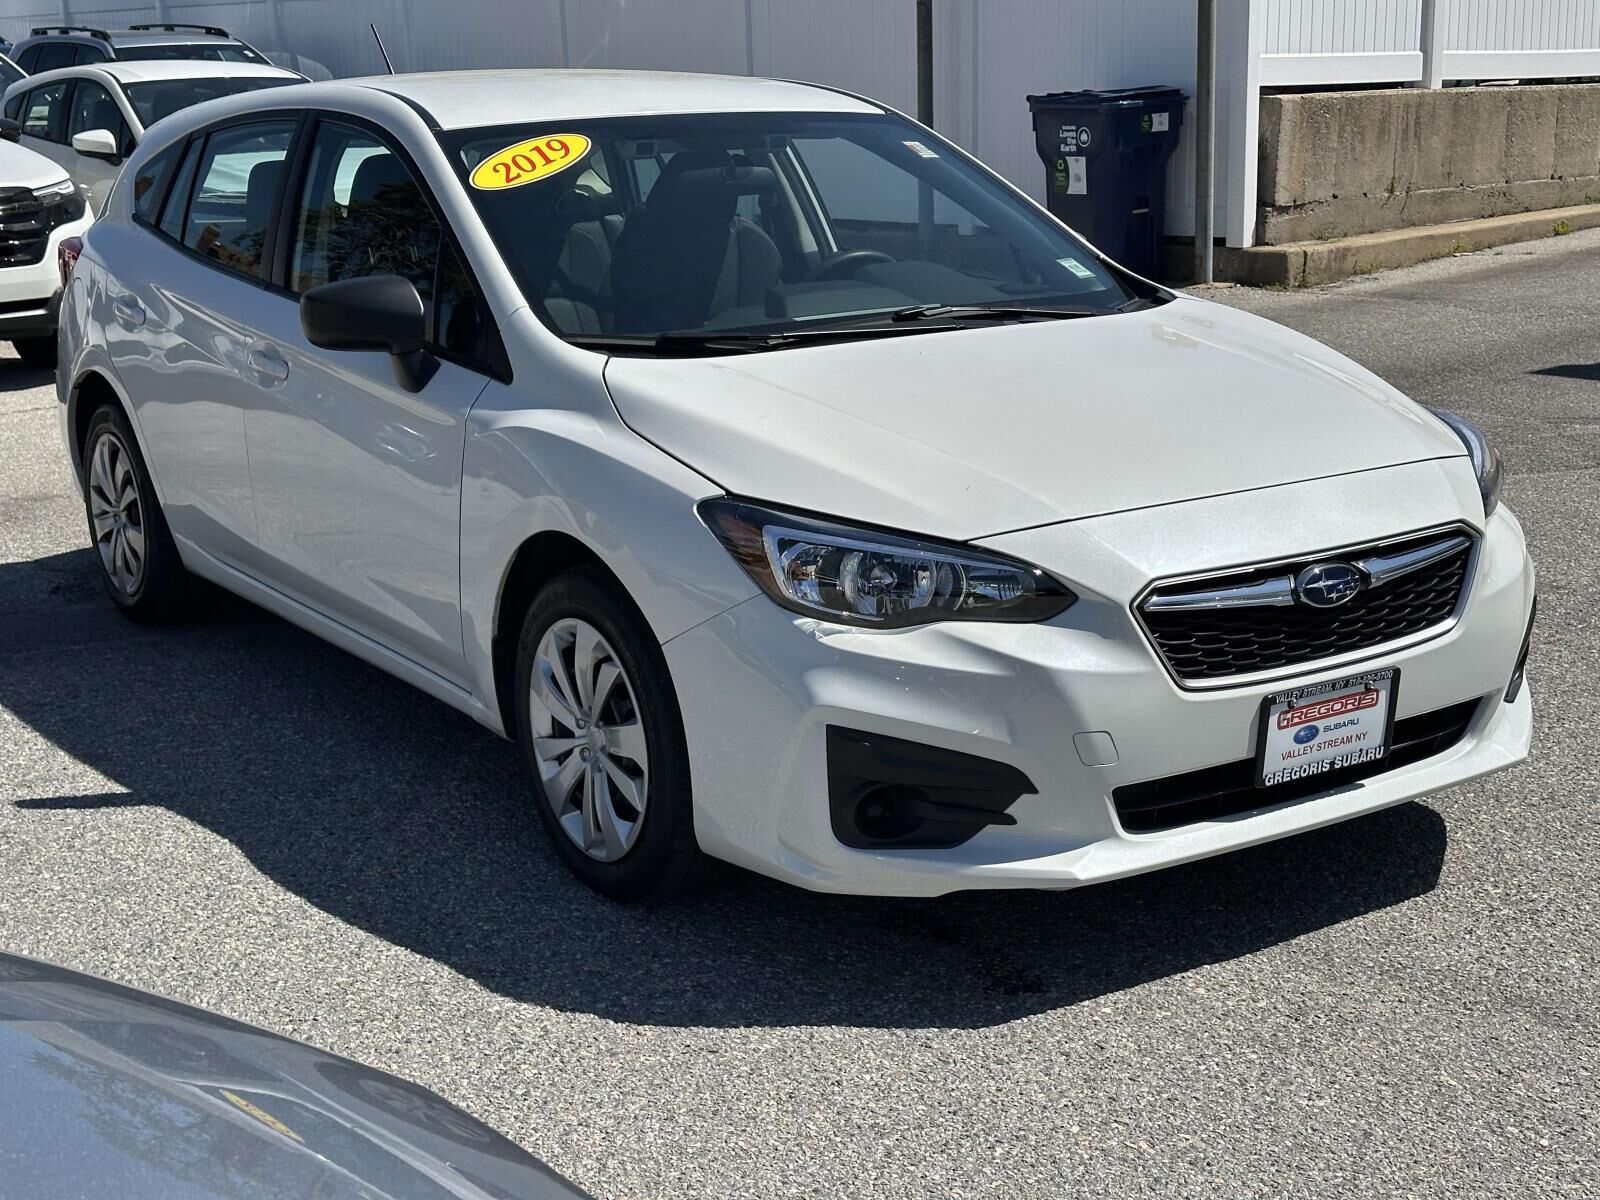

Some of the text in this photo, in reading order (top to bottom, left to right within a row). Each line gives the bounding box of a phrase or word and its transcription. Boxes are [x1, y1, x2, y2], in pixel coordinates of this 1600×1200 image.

[492, 139, 570, 184] 2019
[1275, 690, 1303, 704] VALLEY
[1335, 680, 1347, 691] NY
[1279, 690, 1377, 728] GREGORIS
[1323, 718, 1360, 733] SUBARU
[1281, 731, 1368, 761] VALLEY STREAM NY
[1264, 746, 1385, 787] GREGORIS SUBARU
